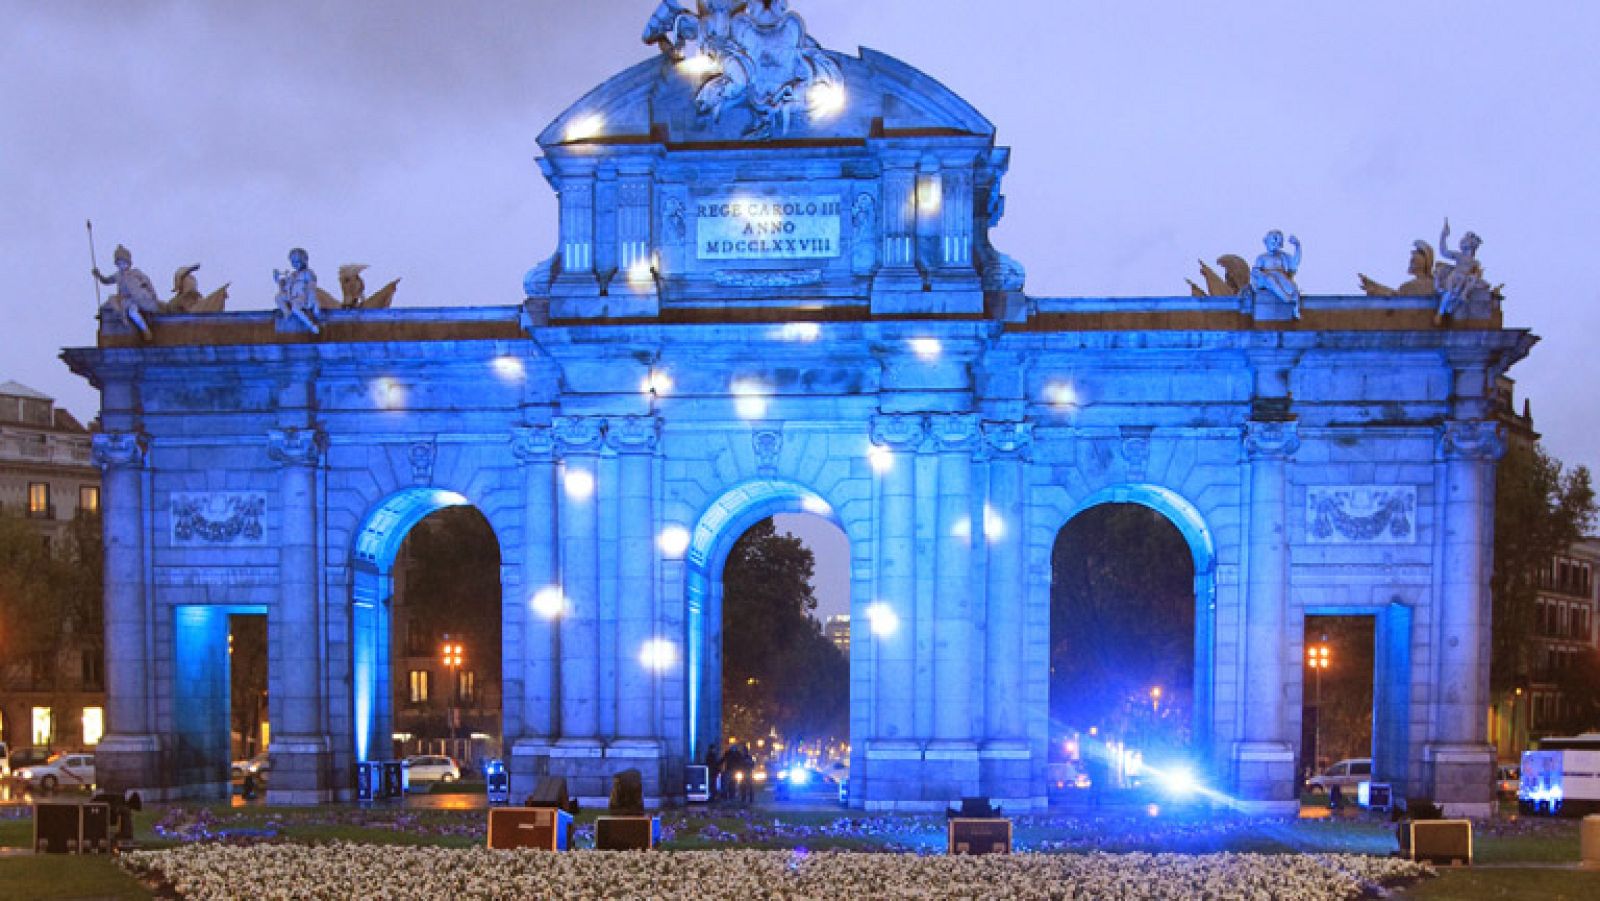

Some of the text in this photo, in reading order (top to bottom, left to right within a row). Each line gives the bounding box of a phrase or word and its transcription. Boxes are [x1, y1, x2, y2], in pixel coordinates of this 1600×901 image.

[697, 201, 840, 217] REGE CAROLO III
[742, 221, 795, 235] ANNO
[706, 239, 830, 253] MDCCLXXVIII
